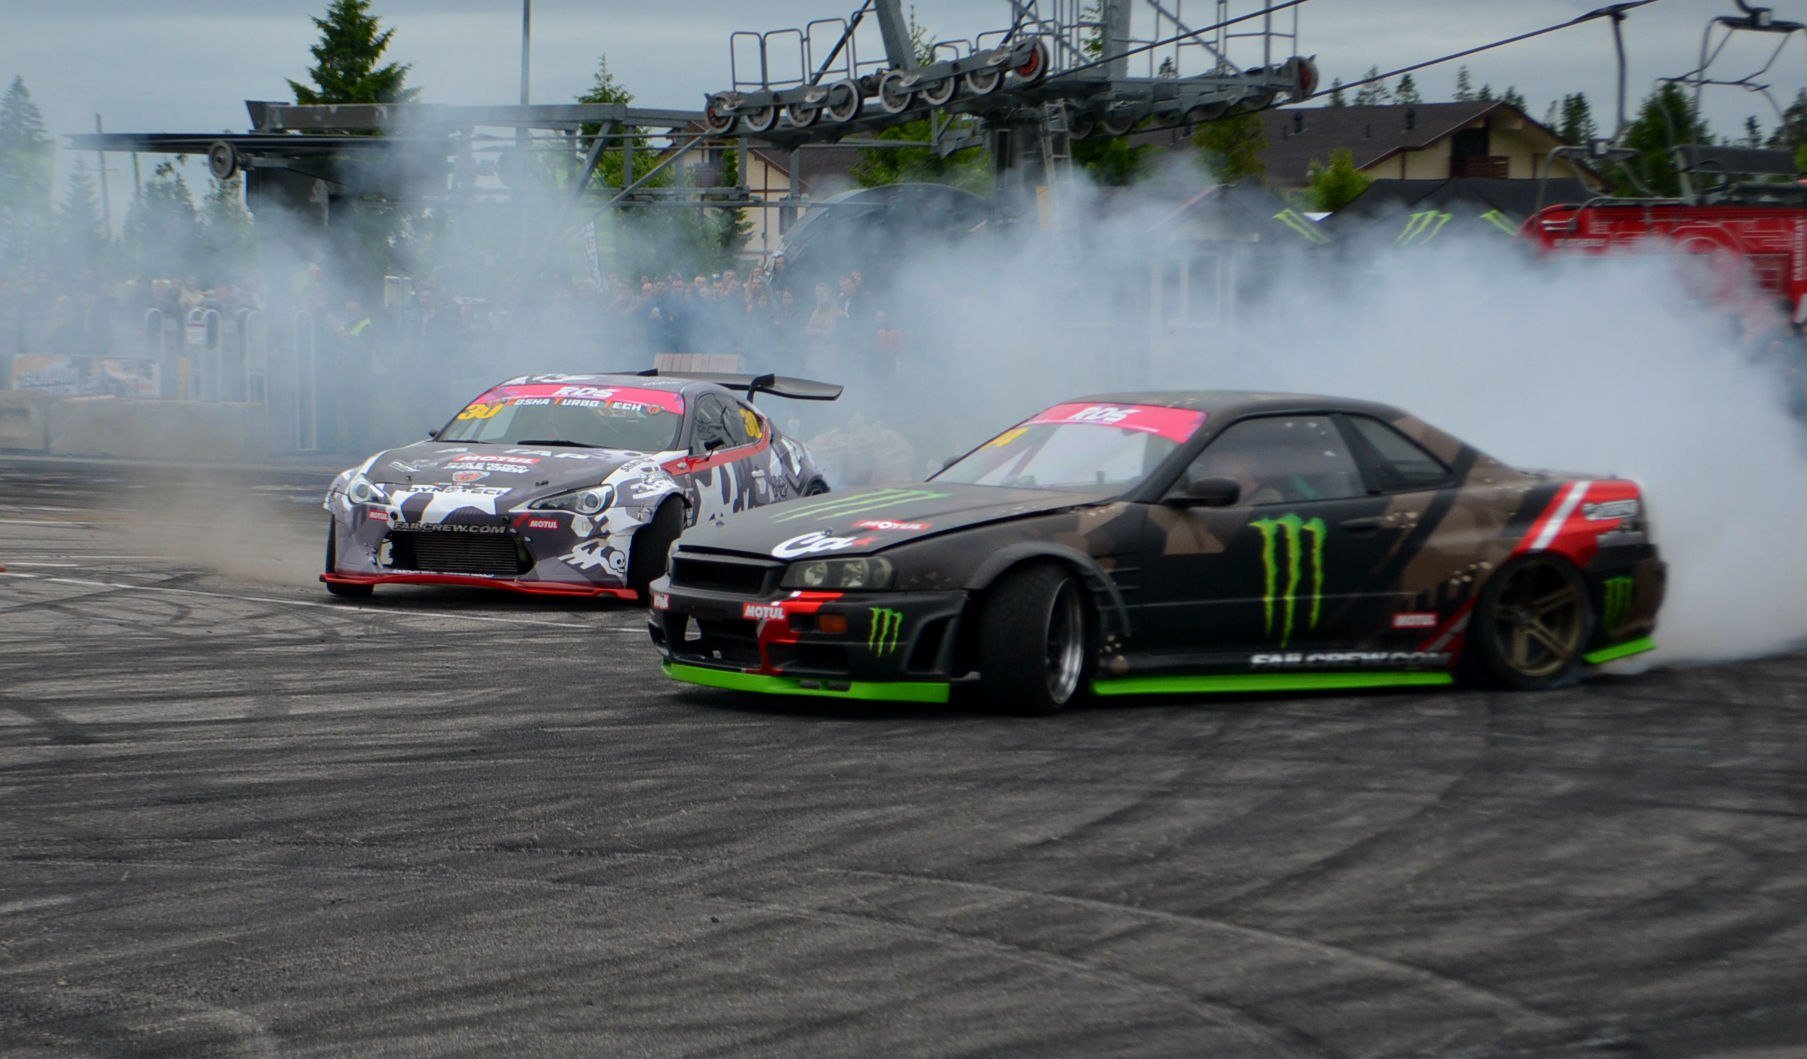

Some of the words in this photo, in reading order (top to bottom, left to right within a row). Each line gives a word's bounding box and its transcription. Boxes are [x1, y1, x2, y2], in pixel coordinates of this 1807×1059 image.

[552, 386, 621, 398] RDS
[506, 398, 550, 406] GOSHA
[553, 398, 599, 407] TURBO
[605, 400, 642, 411] TECH
[1069, 406, 1141, 423] RDS
[459, 455, 537, 464] MOTUL
[529, 519, 558, 529] MOTUL
[859, 520, 922, 530] MOTUL
[743, 605, 785, 619] MOTUL
